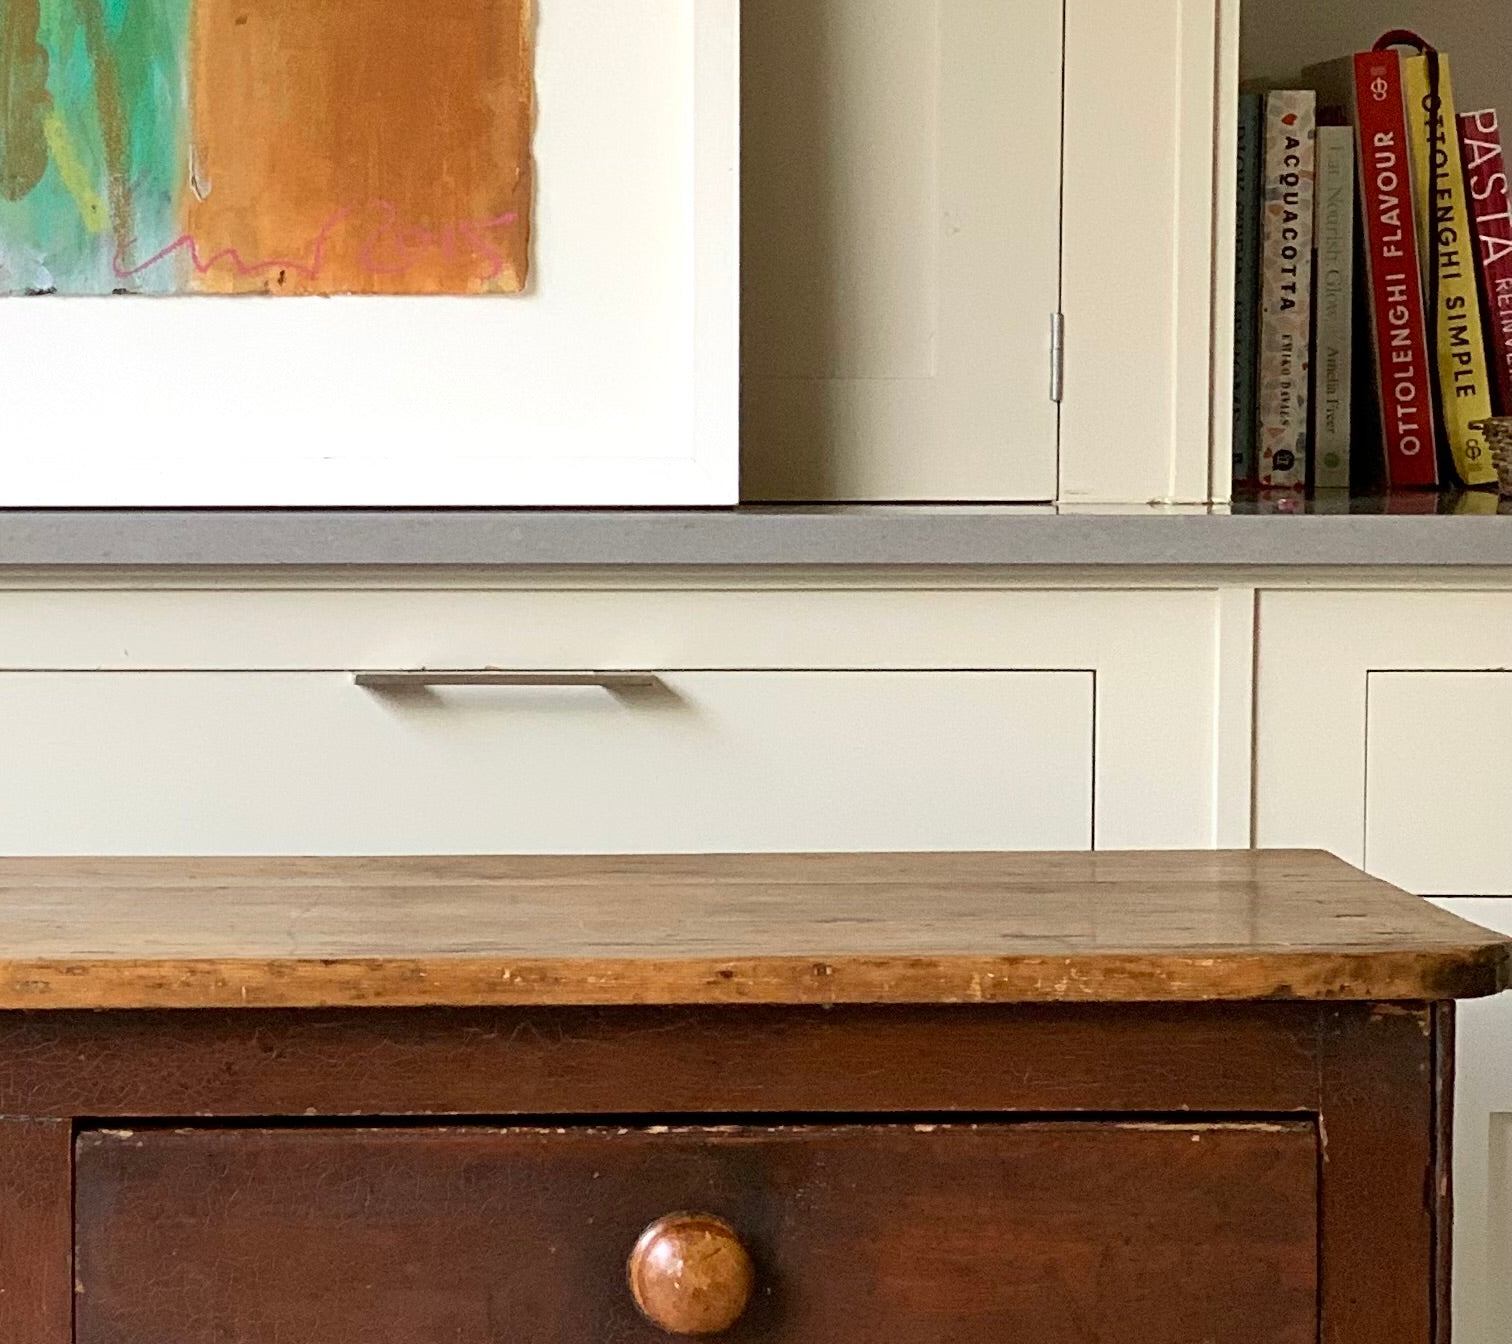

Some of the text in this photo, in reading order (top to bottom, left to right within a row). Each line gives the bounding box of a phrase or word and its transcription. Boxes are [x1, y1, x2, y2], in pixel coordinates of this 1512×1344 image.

[1279, 135, 1300, 312] ACQUACOTTA
[1460, 108, 1512, 267] PASTA
[1373, 131, 1421, 456] OTTOLENGHI FLAVOUR
[1445, 295, 1476, 399] SIMPLE
